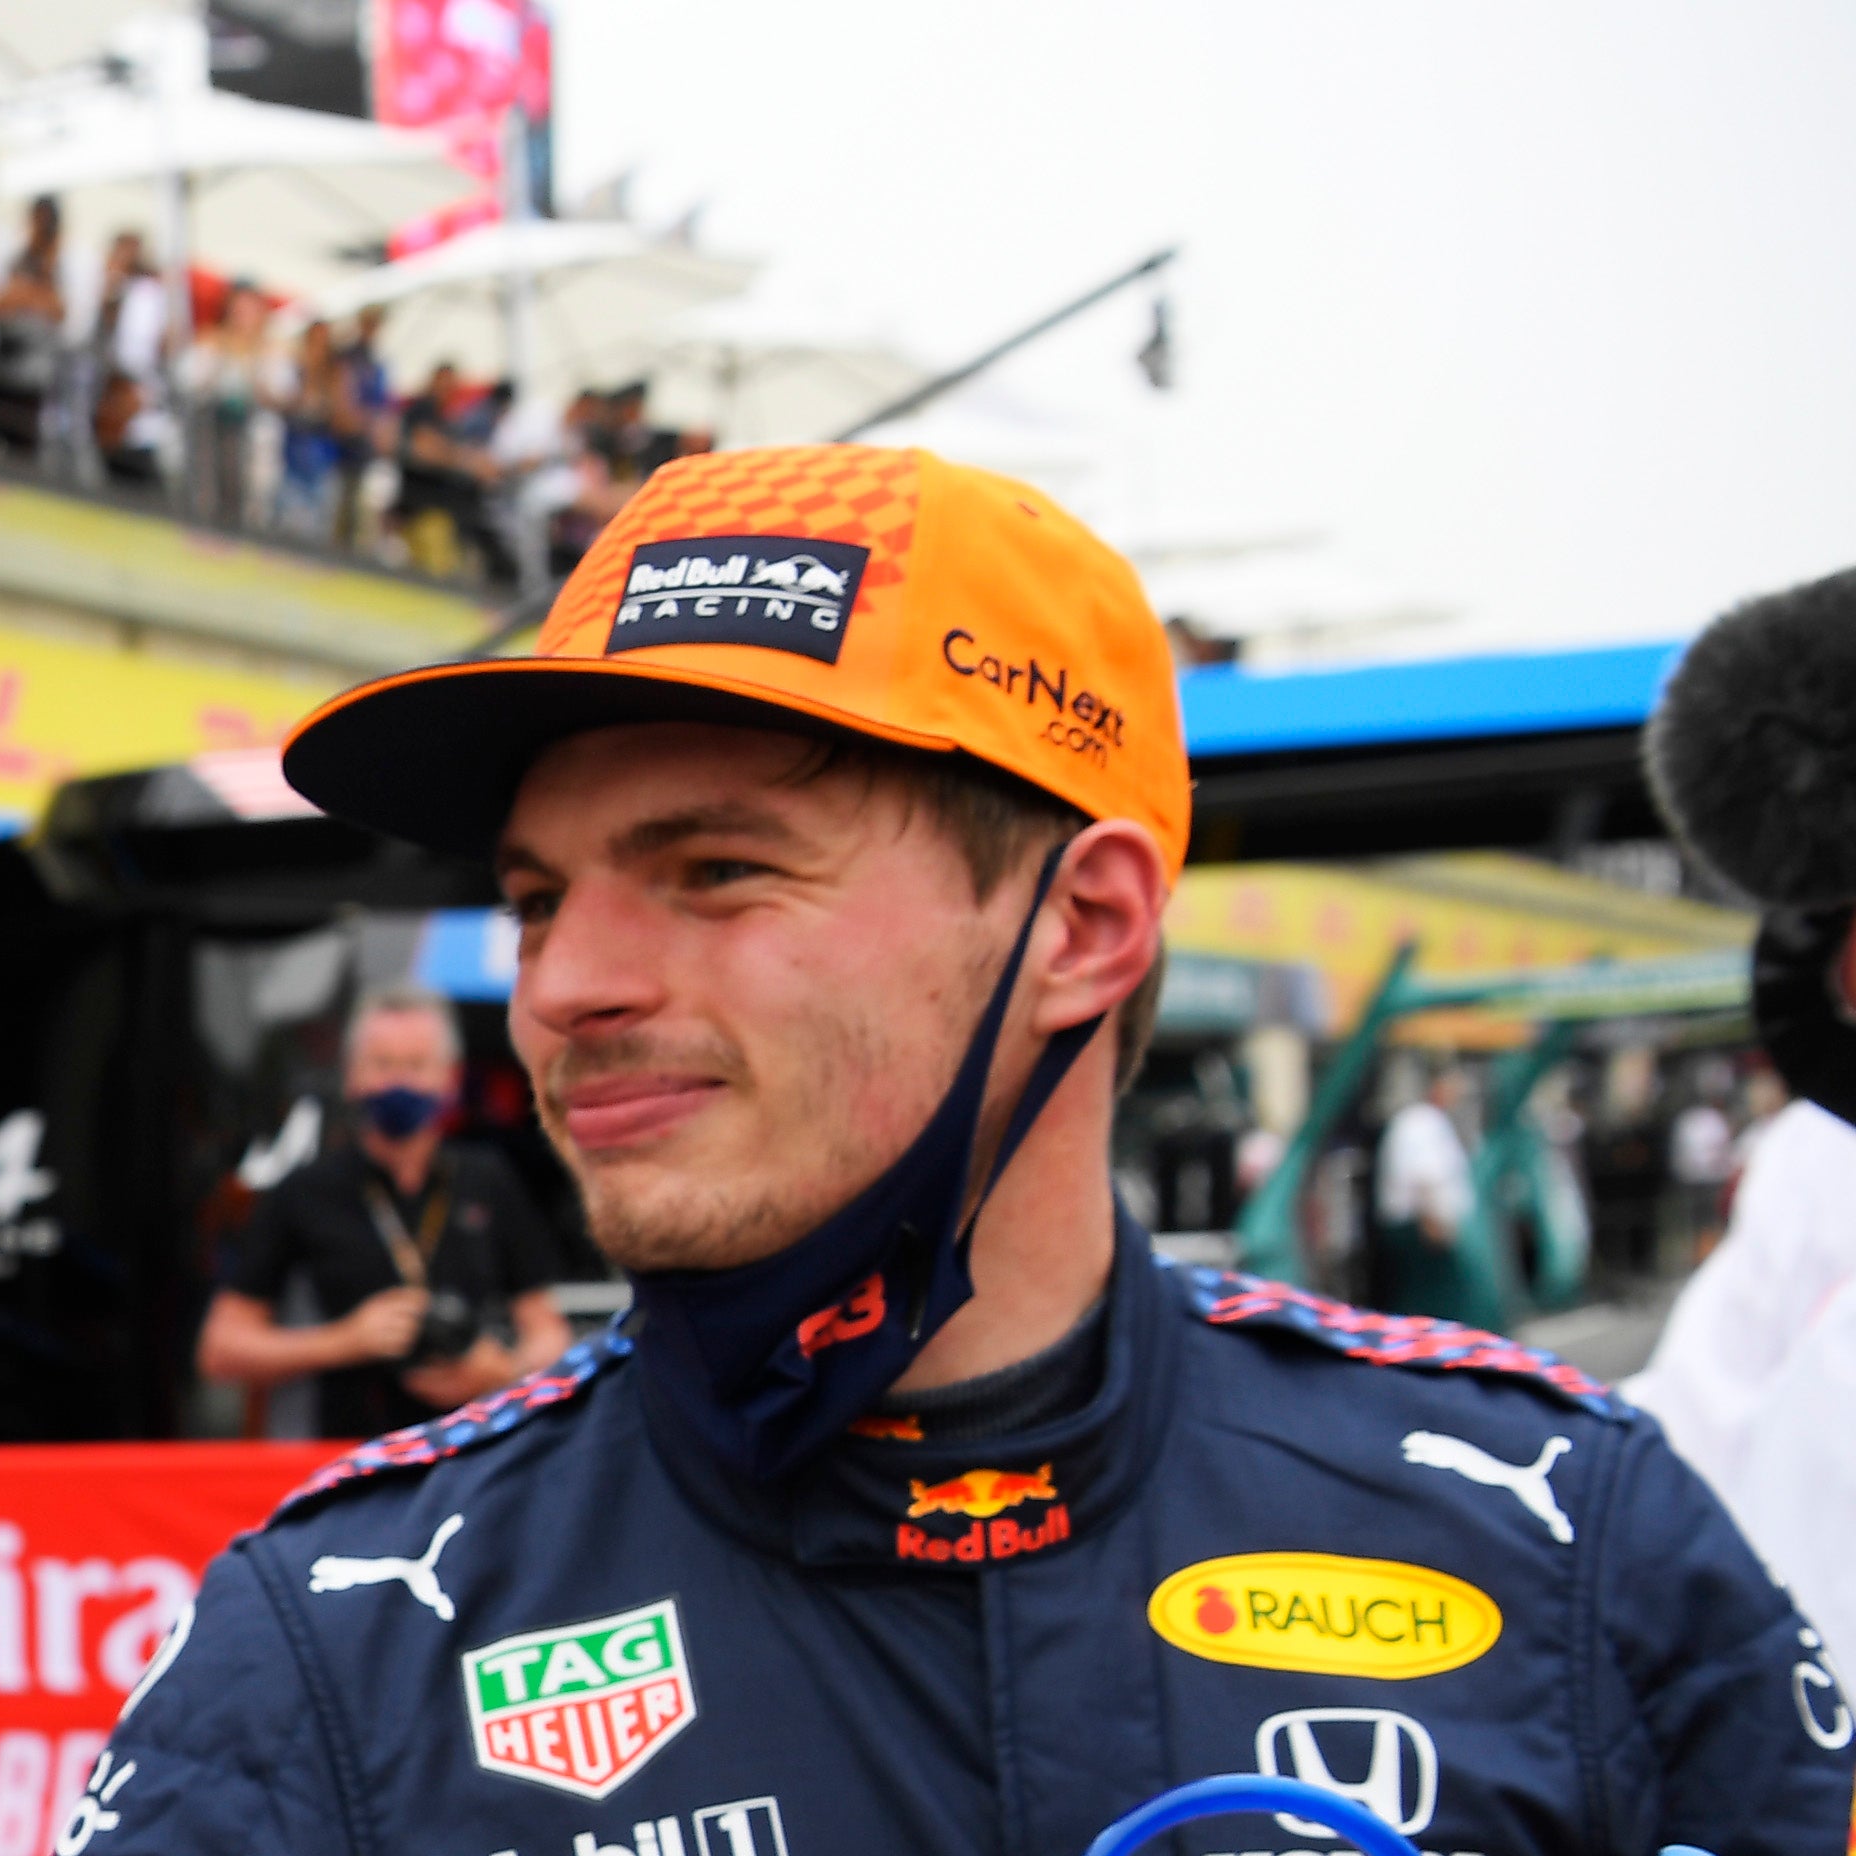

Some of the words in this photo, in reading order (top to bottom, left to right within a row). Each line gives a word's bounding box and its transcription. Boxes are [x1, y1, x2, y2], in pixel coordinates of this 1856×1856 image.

[626, 556, 690, 595] Red
[684, 554, 750, 587] Bull
[616, 596, 840, 632] RACING
[942, 628, 1125, 748] CarNext
[895, 1521, 986, 1562] Red
[988, 1503, 1071, 1559] Bull
[1247, 1588, 1451, 1646] RAUCH
[481, 1619, 664, 1704] TAG
[489, 1680, 678, 1782] HEUER
